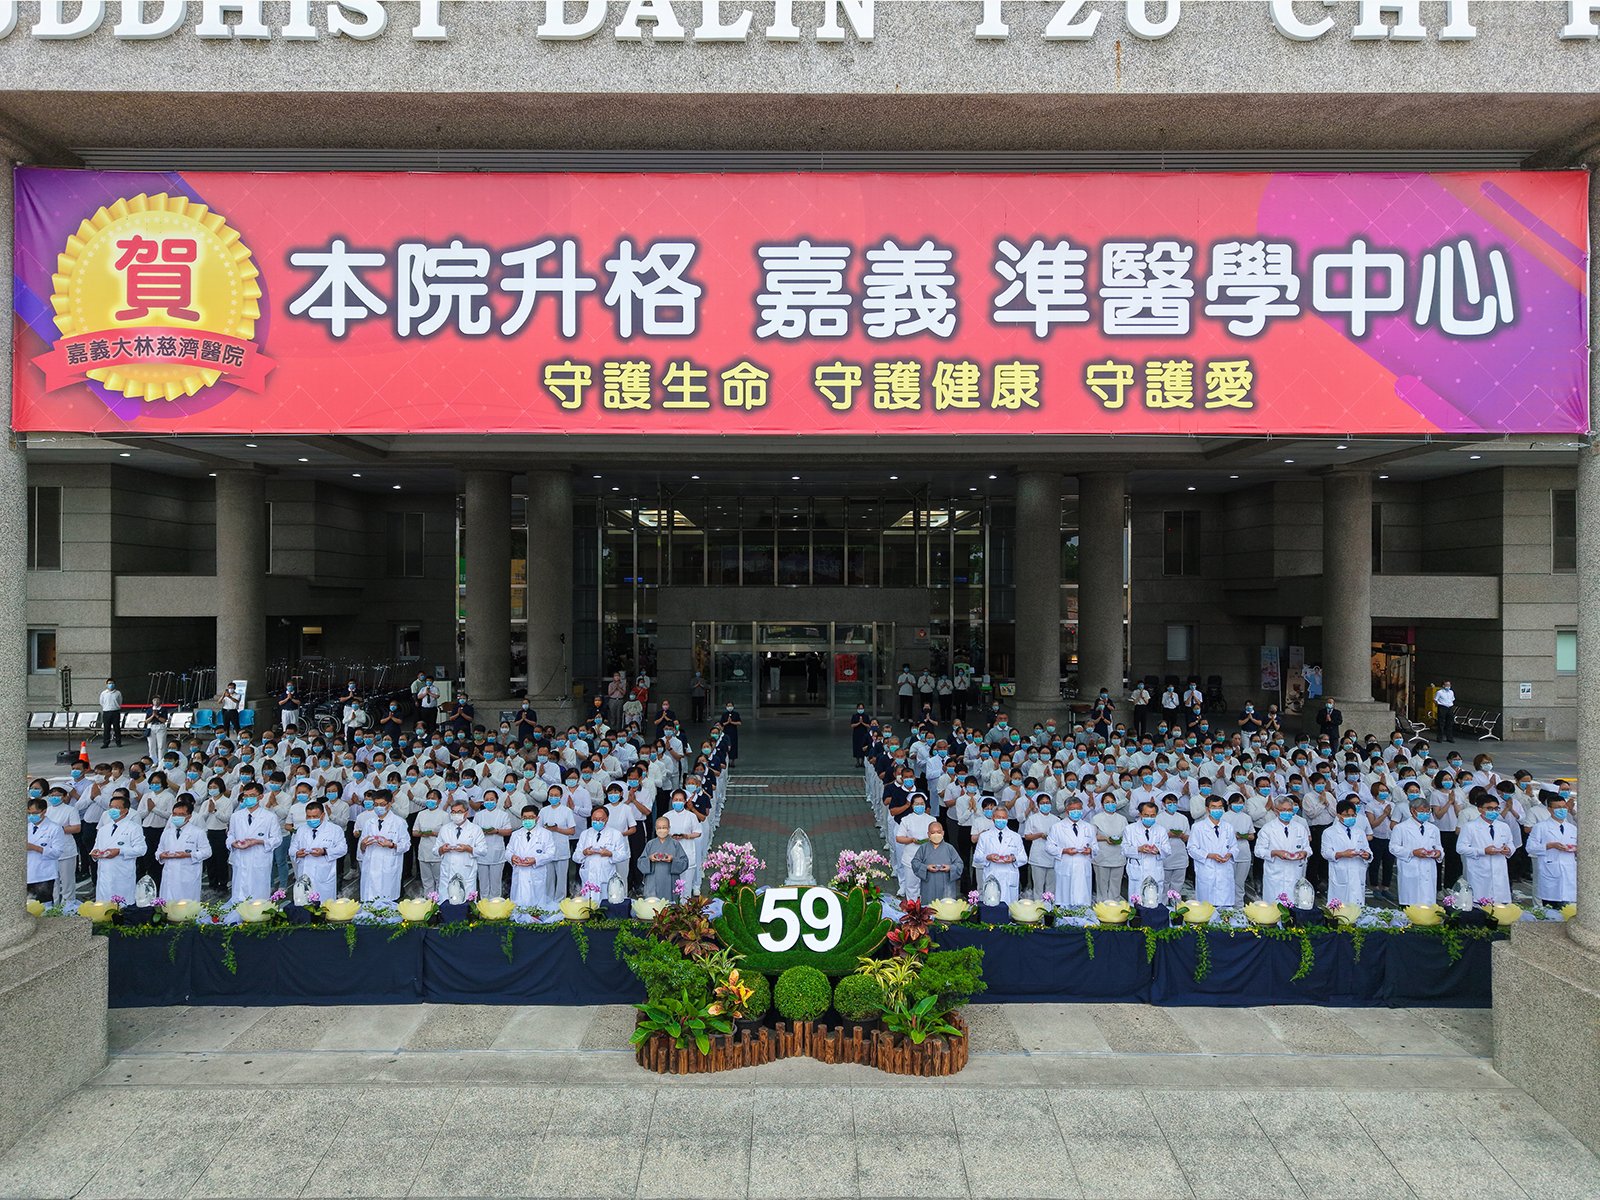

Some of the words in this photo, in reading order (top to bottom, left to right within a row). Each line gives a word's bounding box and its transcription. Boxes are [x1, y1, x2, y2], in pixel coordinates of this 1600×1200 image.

[115, 235, 200, 322] 賀
[289, 239, 702, 339] 本院升格
[756, 239, 957, 339] 嘉義
[993, 239, 1514, 339] 準醫學中心
[65, 335, 245, 367] 嘉義大林慈濟醫院
[543, 360, 770, 410] 守護生命
[815, 360, 1040, 410] 守護健康
[1085, 360, 1254, 410] 守護愛
[756, 886, 843, 953] 59
